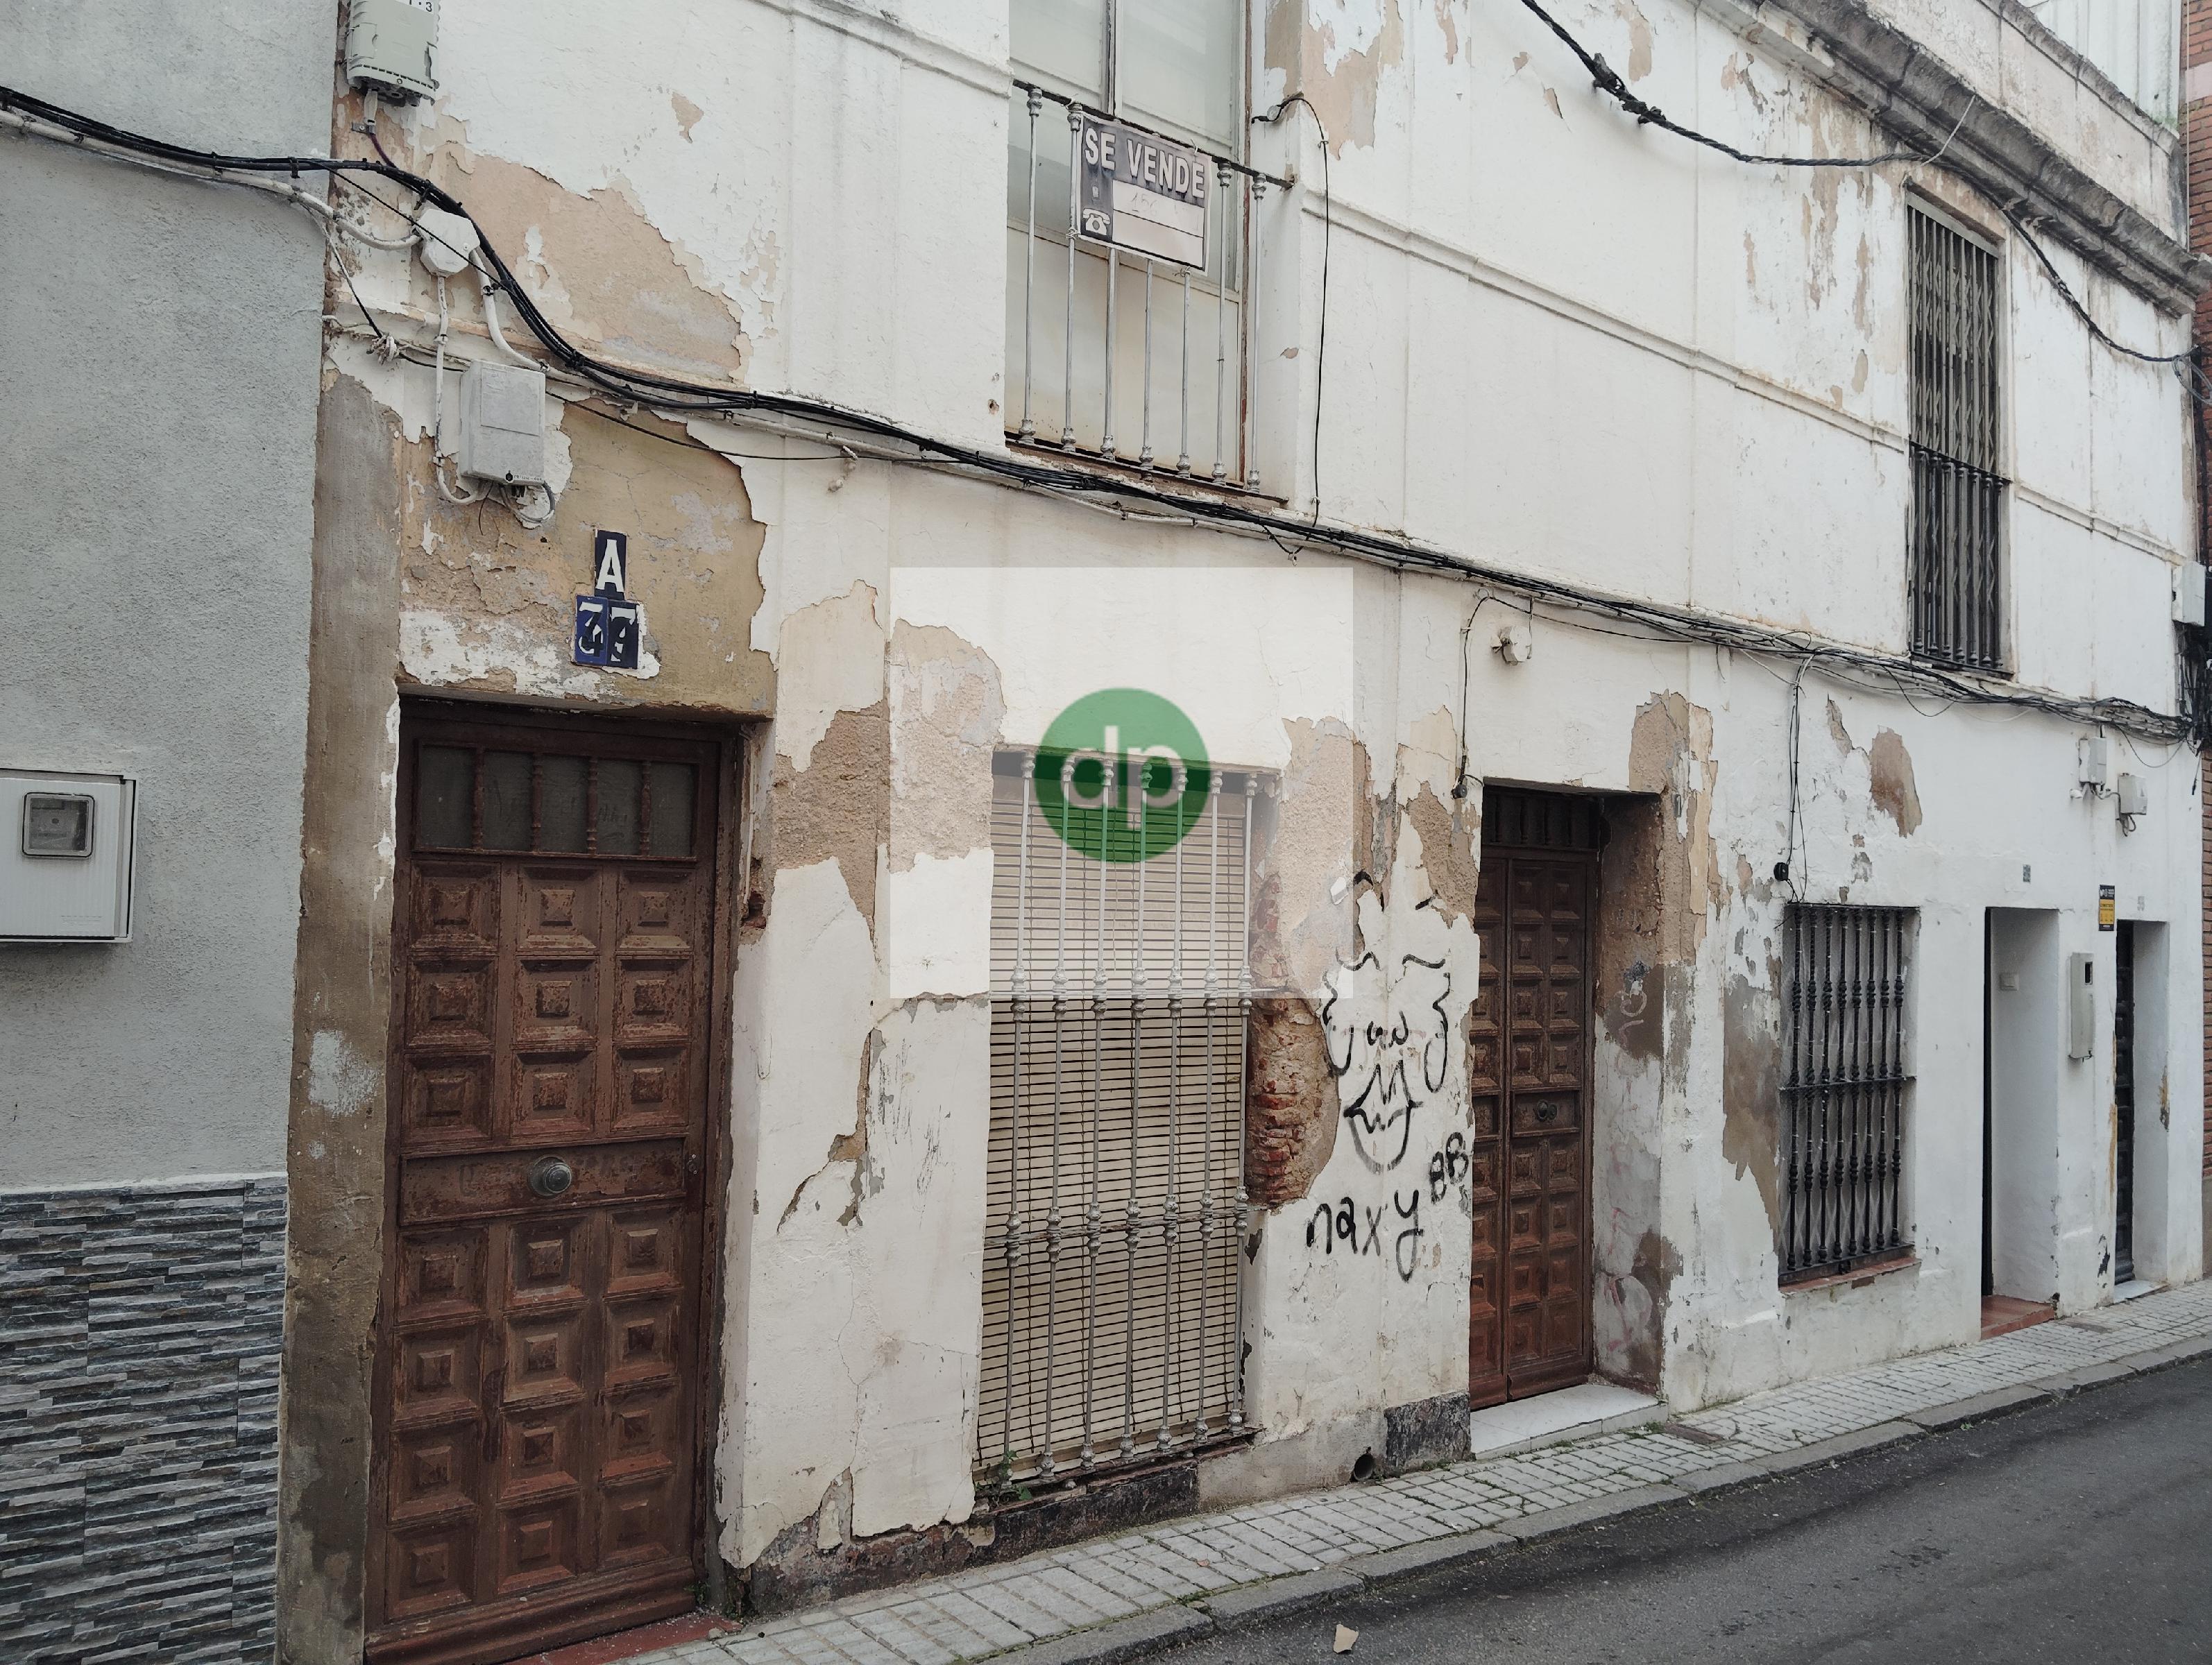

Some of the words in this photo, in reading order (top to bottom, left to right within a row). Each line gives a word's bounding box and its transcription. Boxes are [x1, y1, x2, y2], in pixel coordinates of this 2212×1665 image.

[1084, 128, 1116, 171] SE
[1127, 139, 1205, 198] VENDE
[595, 539, 624, 592] A
